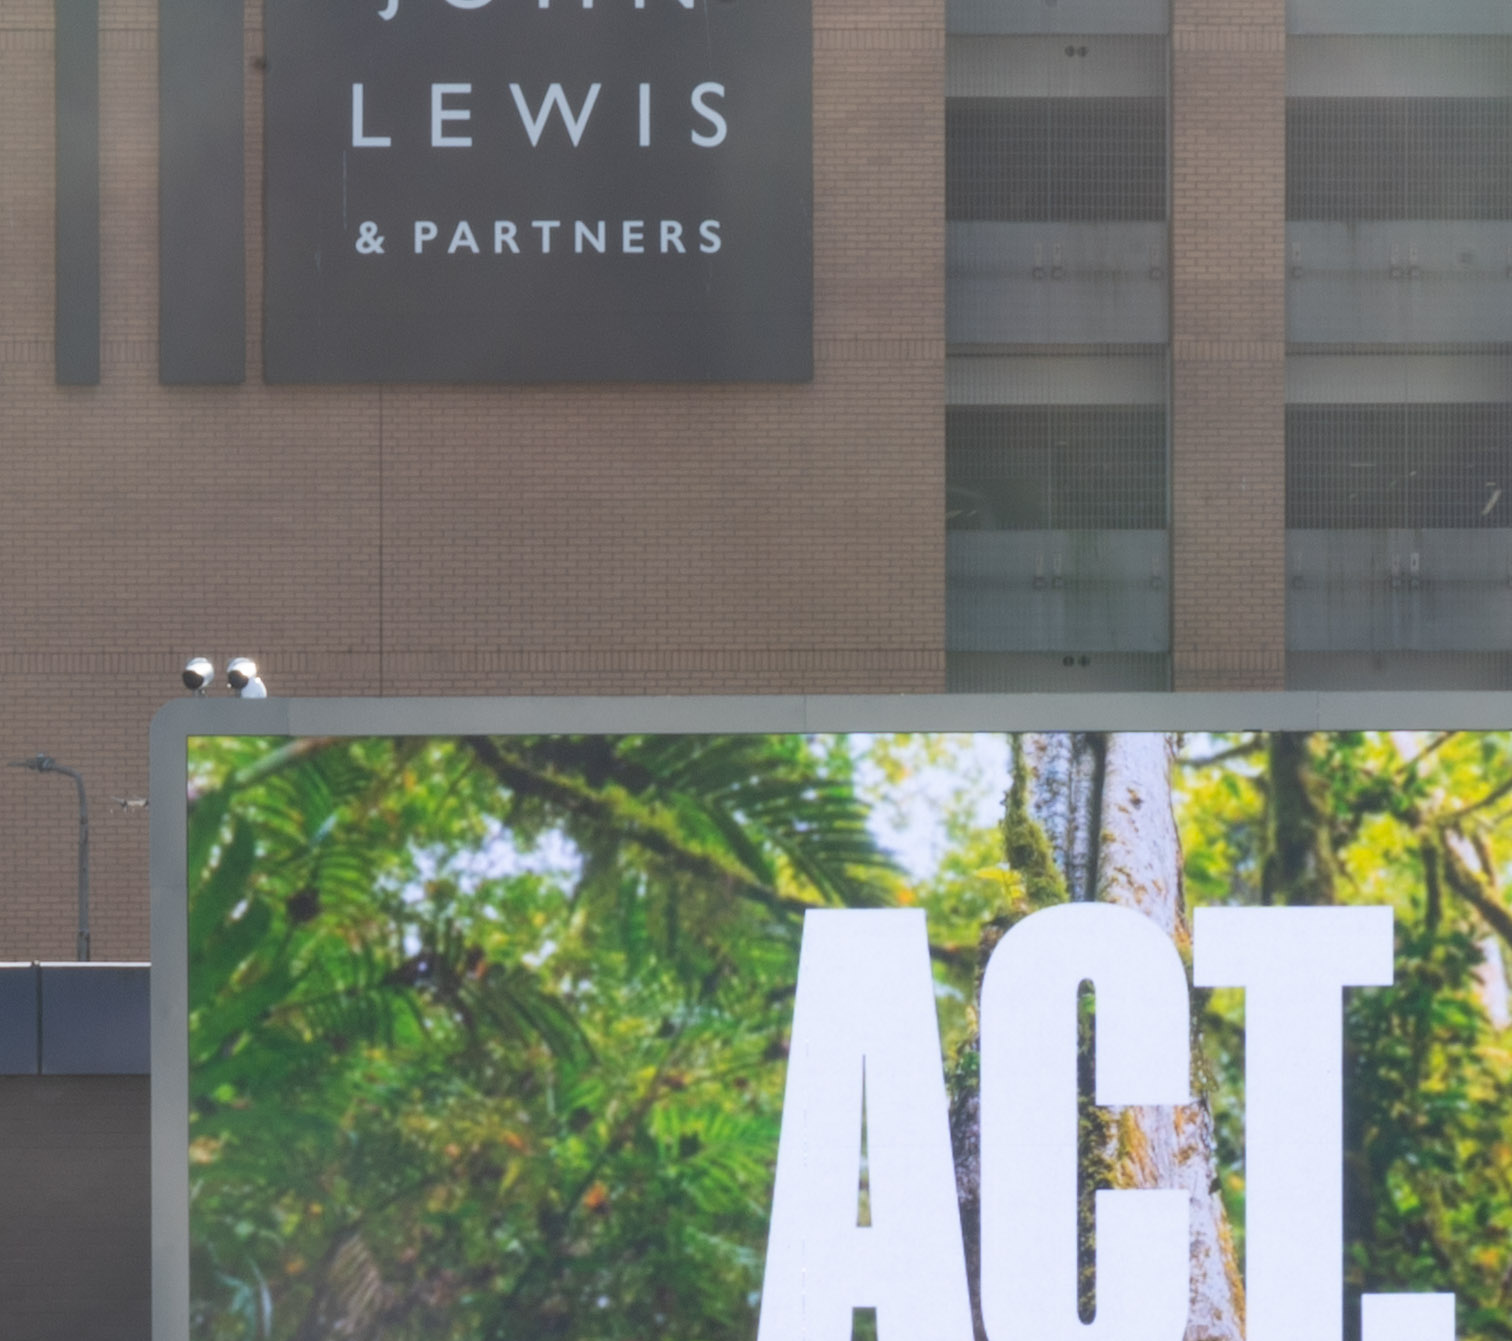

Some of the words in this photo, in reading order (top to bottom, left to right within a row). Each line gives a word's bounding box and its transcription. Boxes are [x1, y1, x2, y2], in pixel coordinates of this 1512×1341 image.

[352, 81, 728, 148] LEWIS
[355, 221, 386, 255] &
[413, 219, 723, 255] PARTNERS
